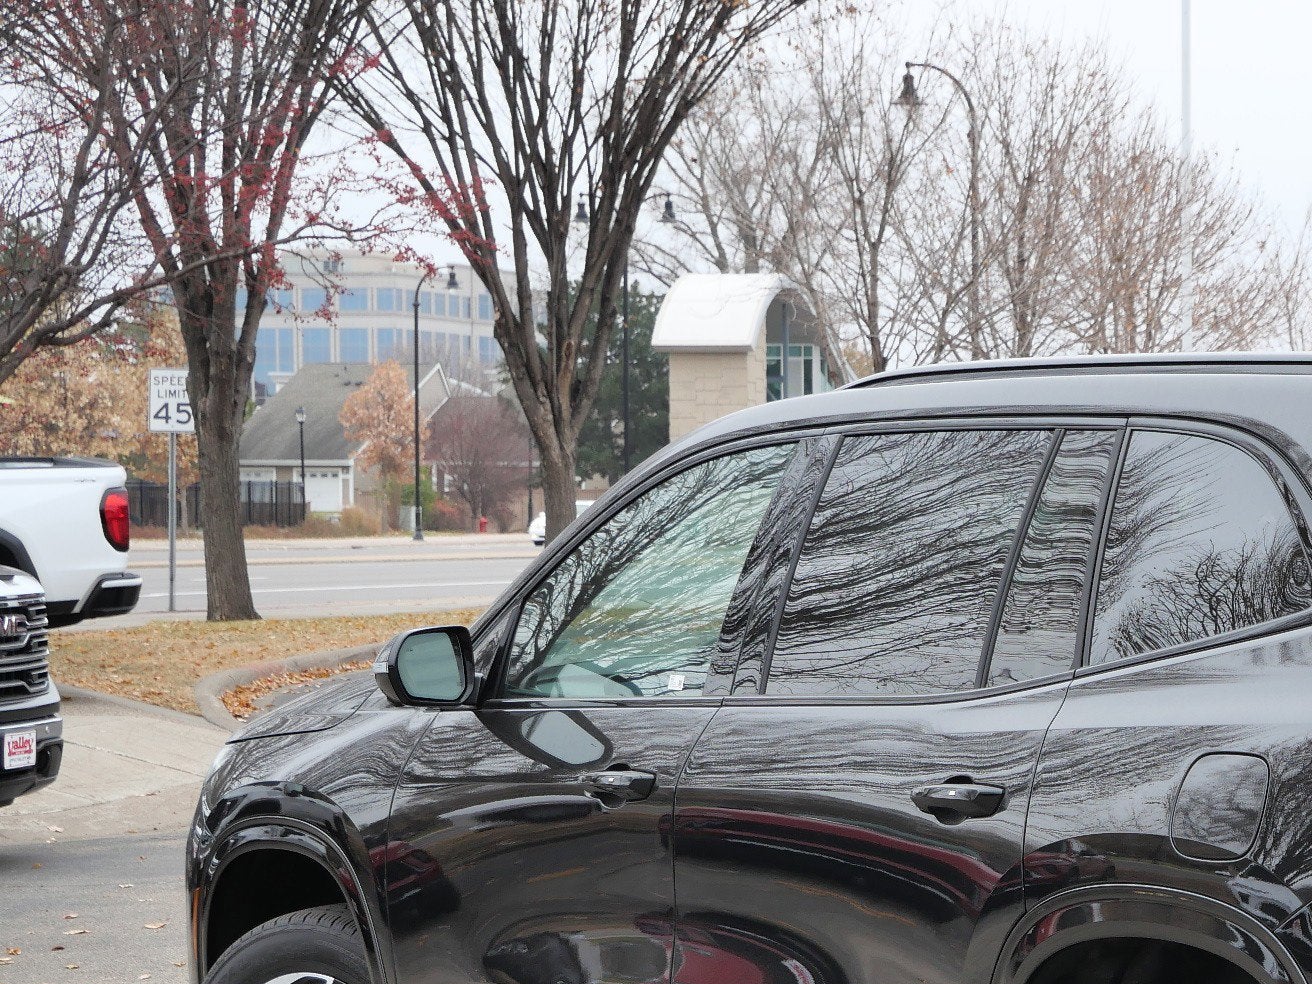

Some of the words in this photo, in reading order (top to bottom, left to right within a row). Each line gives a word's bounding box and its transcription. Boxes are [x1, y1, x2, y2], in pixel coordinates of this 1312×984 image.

[153, 376, 185, 386] SPEE
[157, 389, 187, 399] LIMIT
[153, 402, 192, 424] 45
